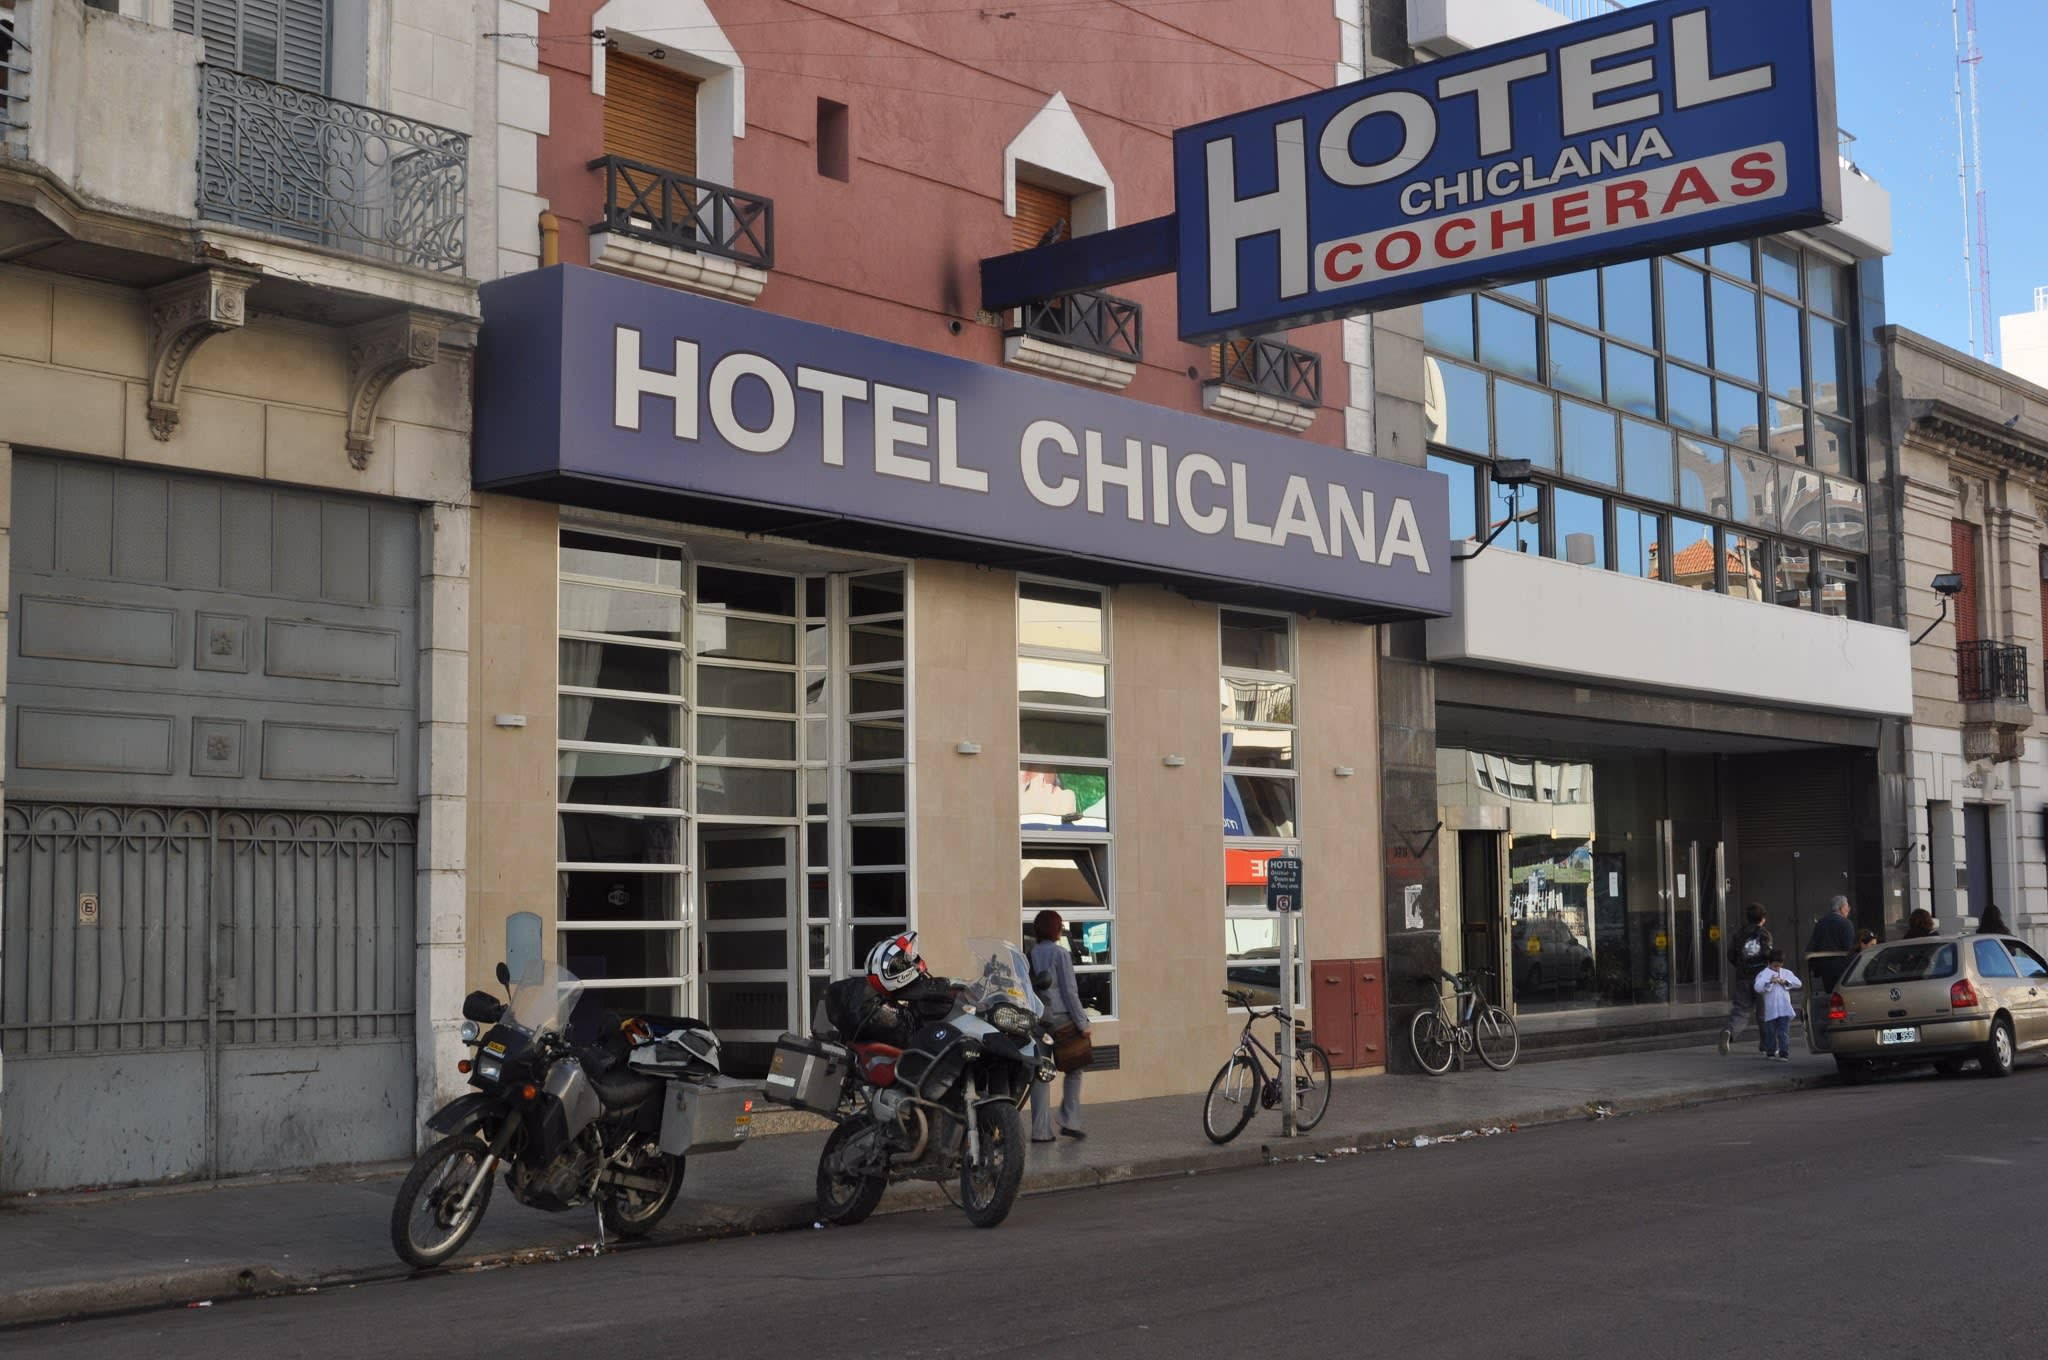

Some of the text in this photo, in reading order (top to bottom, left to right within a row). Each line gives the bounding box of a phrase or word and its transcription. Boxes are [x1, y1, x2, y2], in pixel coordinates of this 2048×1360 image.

[1206, 9, 1775, 315] HOTEL
[1323, 151, 1777, 283] COCHERAS
[1400, 127, 1672, 216] CHICLANA
[615, 326, 1432, 575] HOTEL CHICLANA
[1270, 860, 1299, 869] HOTEL
